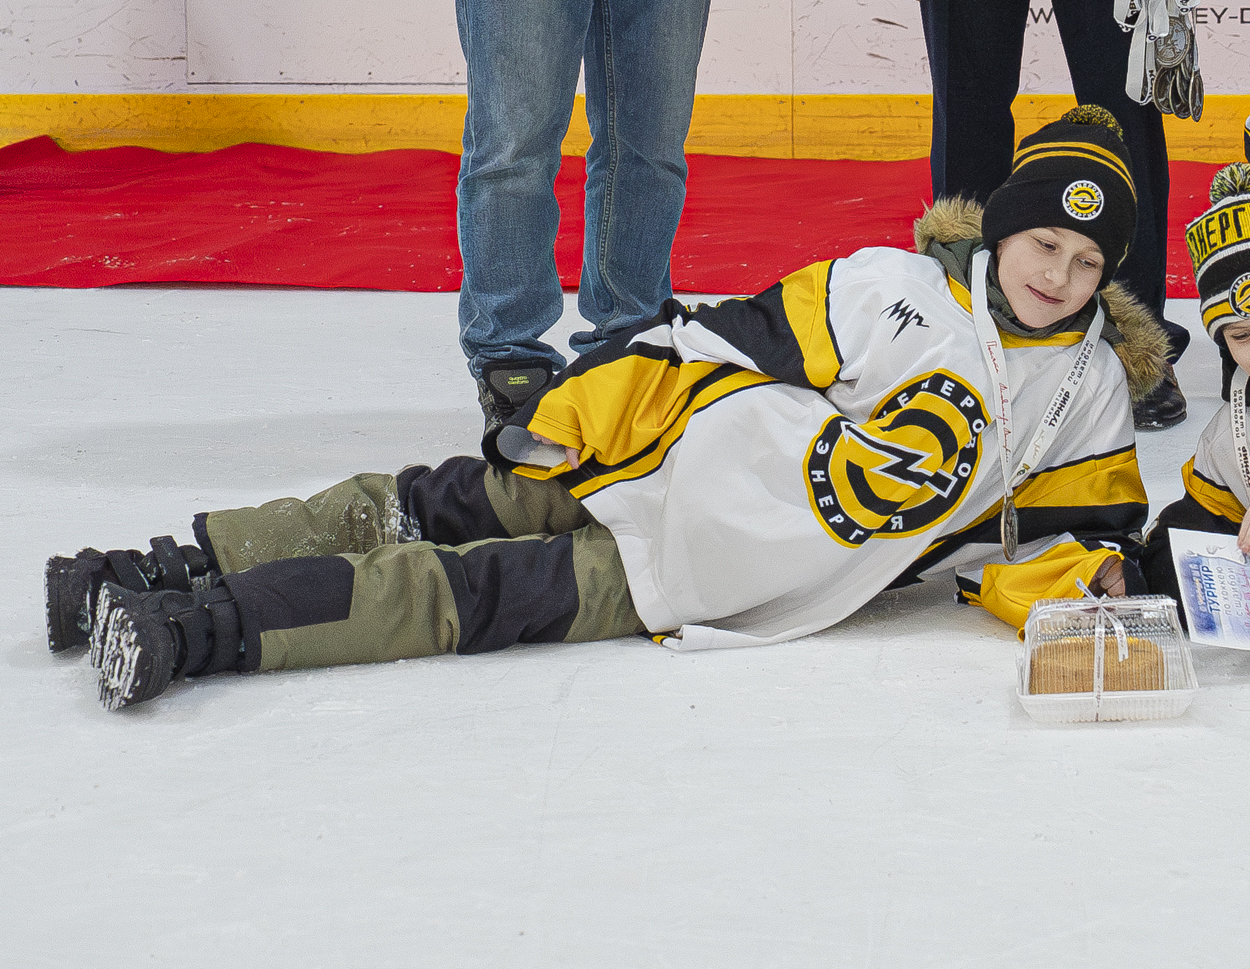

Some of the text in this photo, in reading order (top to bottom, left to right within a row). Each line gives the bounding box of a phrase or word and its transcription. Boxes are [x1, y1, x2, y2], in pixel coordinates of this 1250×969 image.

[1048, 390, 1071, 428] ТУРНИР
[810, 440, 904, 541] ЭНЕРГЯ
[1201, 565, 1222, 613] ТУРНИР
